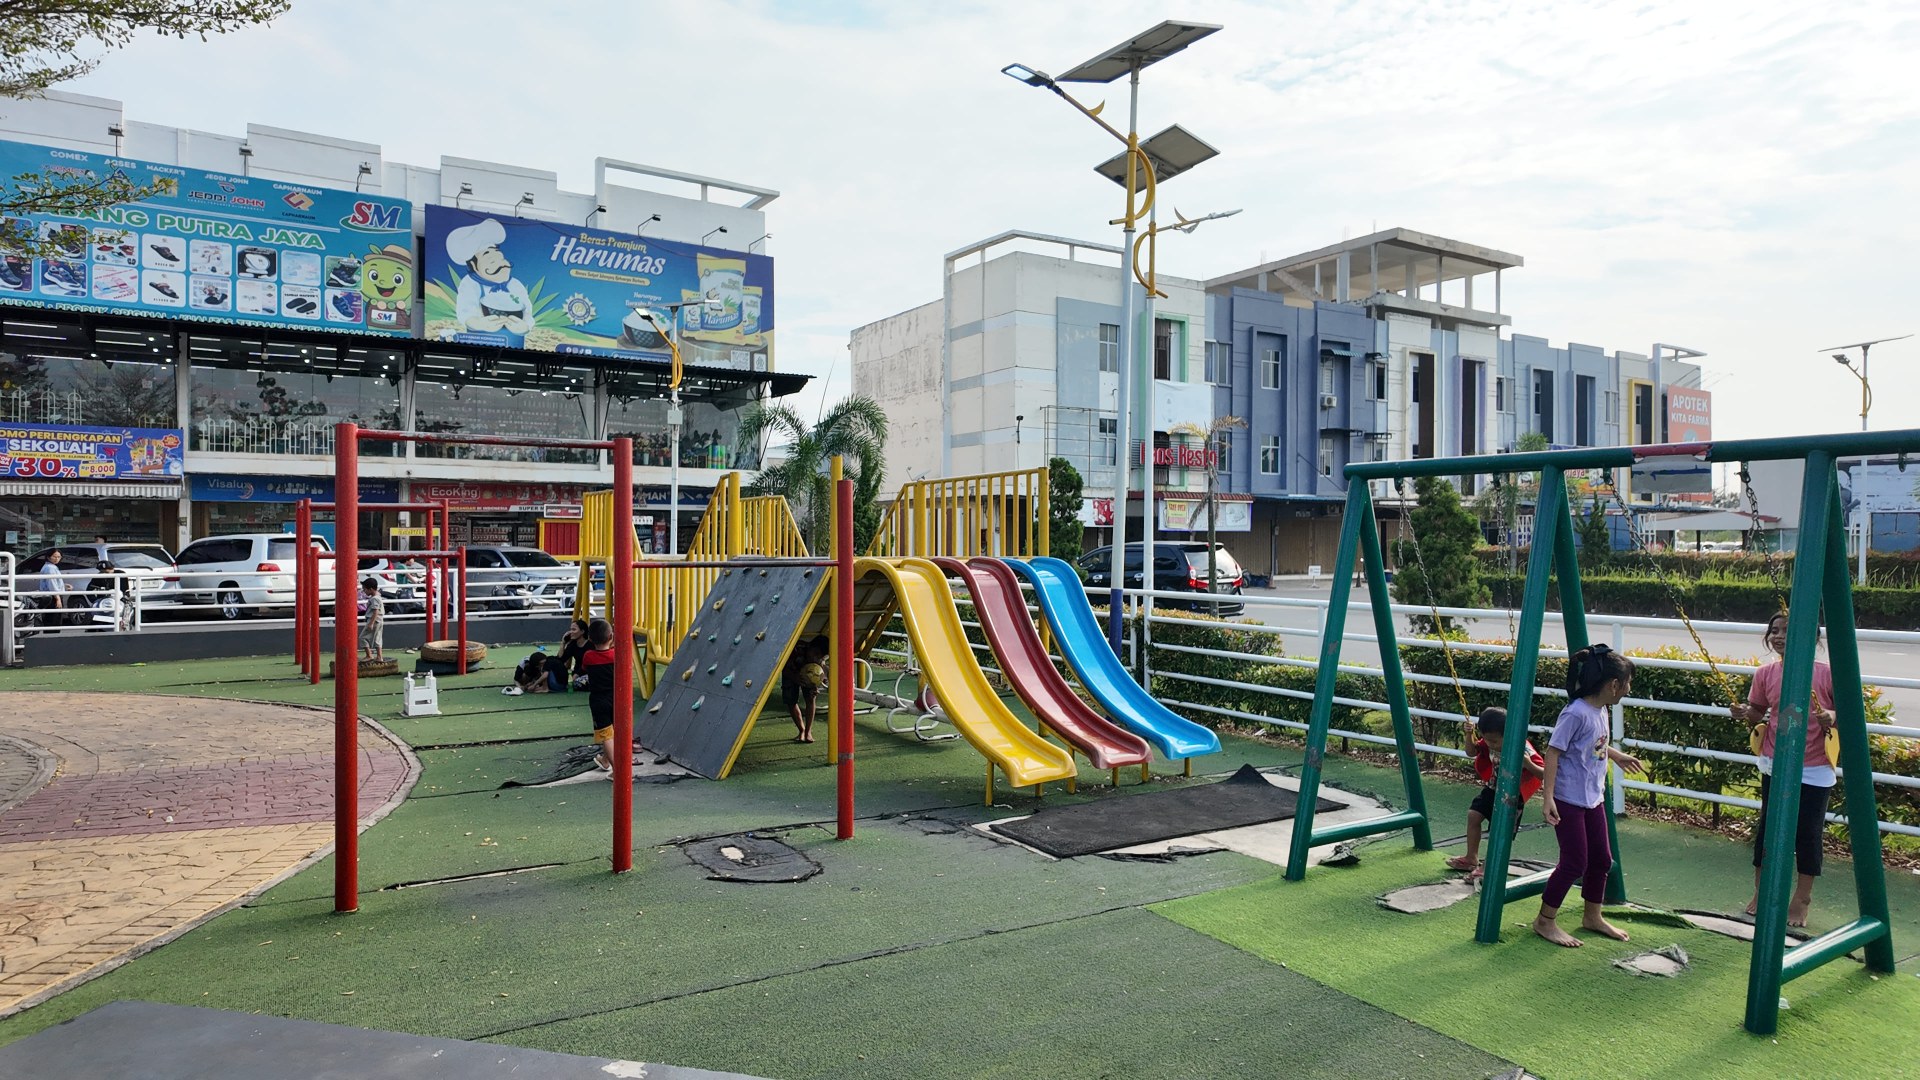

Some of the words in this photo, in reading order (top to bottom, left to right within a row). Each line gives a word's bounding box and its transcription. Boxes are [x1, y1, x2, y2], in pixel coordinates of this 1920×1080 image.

[50, 151, 88, 162] COMEX
[204, 173, 227, 182] JEDDI
[228, 177, 249, 185] JOHN
[229, 196, 265, 208] JOHN
[350, 200, 402, 229] SM
[157, 213, 254, 242] PUTRA
[259, 227, 326, 250] JAYA
[579, 232, 606, 246] Beras
[607, 236, 647, 254] Premium
[550, 235, 667, 276] Harumas
[377, 312, 393, 321] SM
[1672, 394, 1708, 413] APOTEK
[1671, 411, 1687, 424] KITA
[1688, 414, 1710, 426] FARMA
[29, 430, 121, 444] PERLENGKAPAN
[9, 439, 95, 454] SEKOLAH
[1177, 443, 1217, 468] Resto
[90, 464, 115, 474] 8.000
[431, 486, 478, 499] EcoKing
